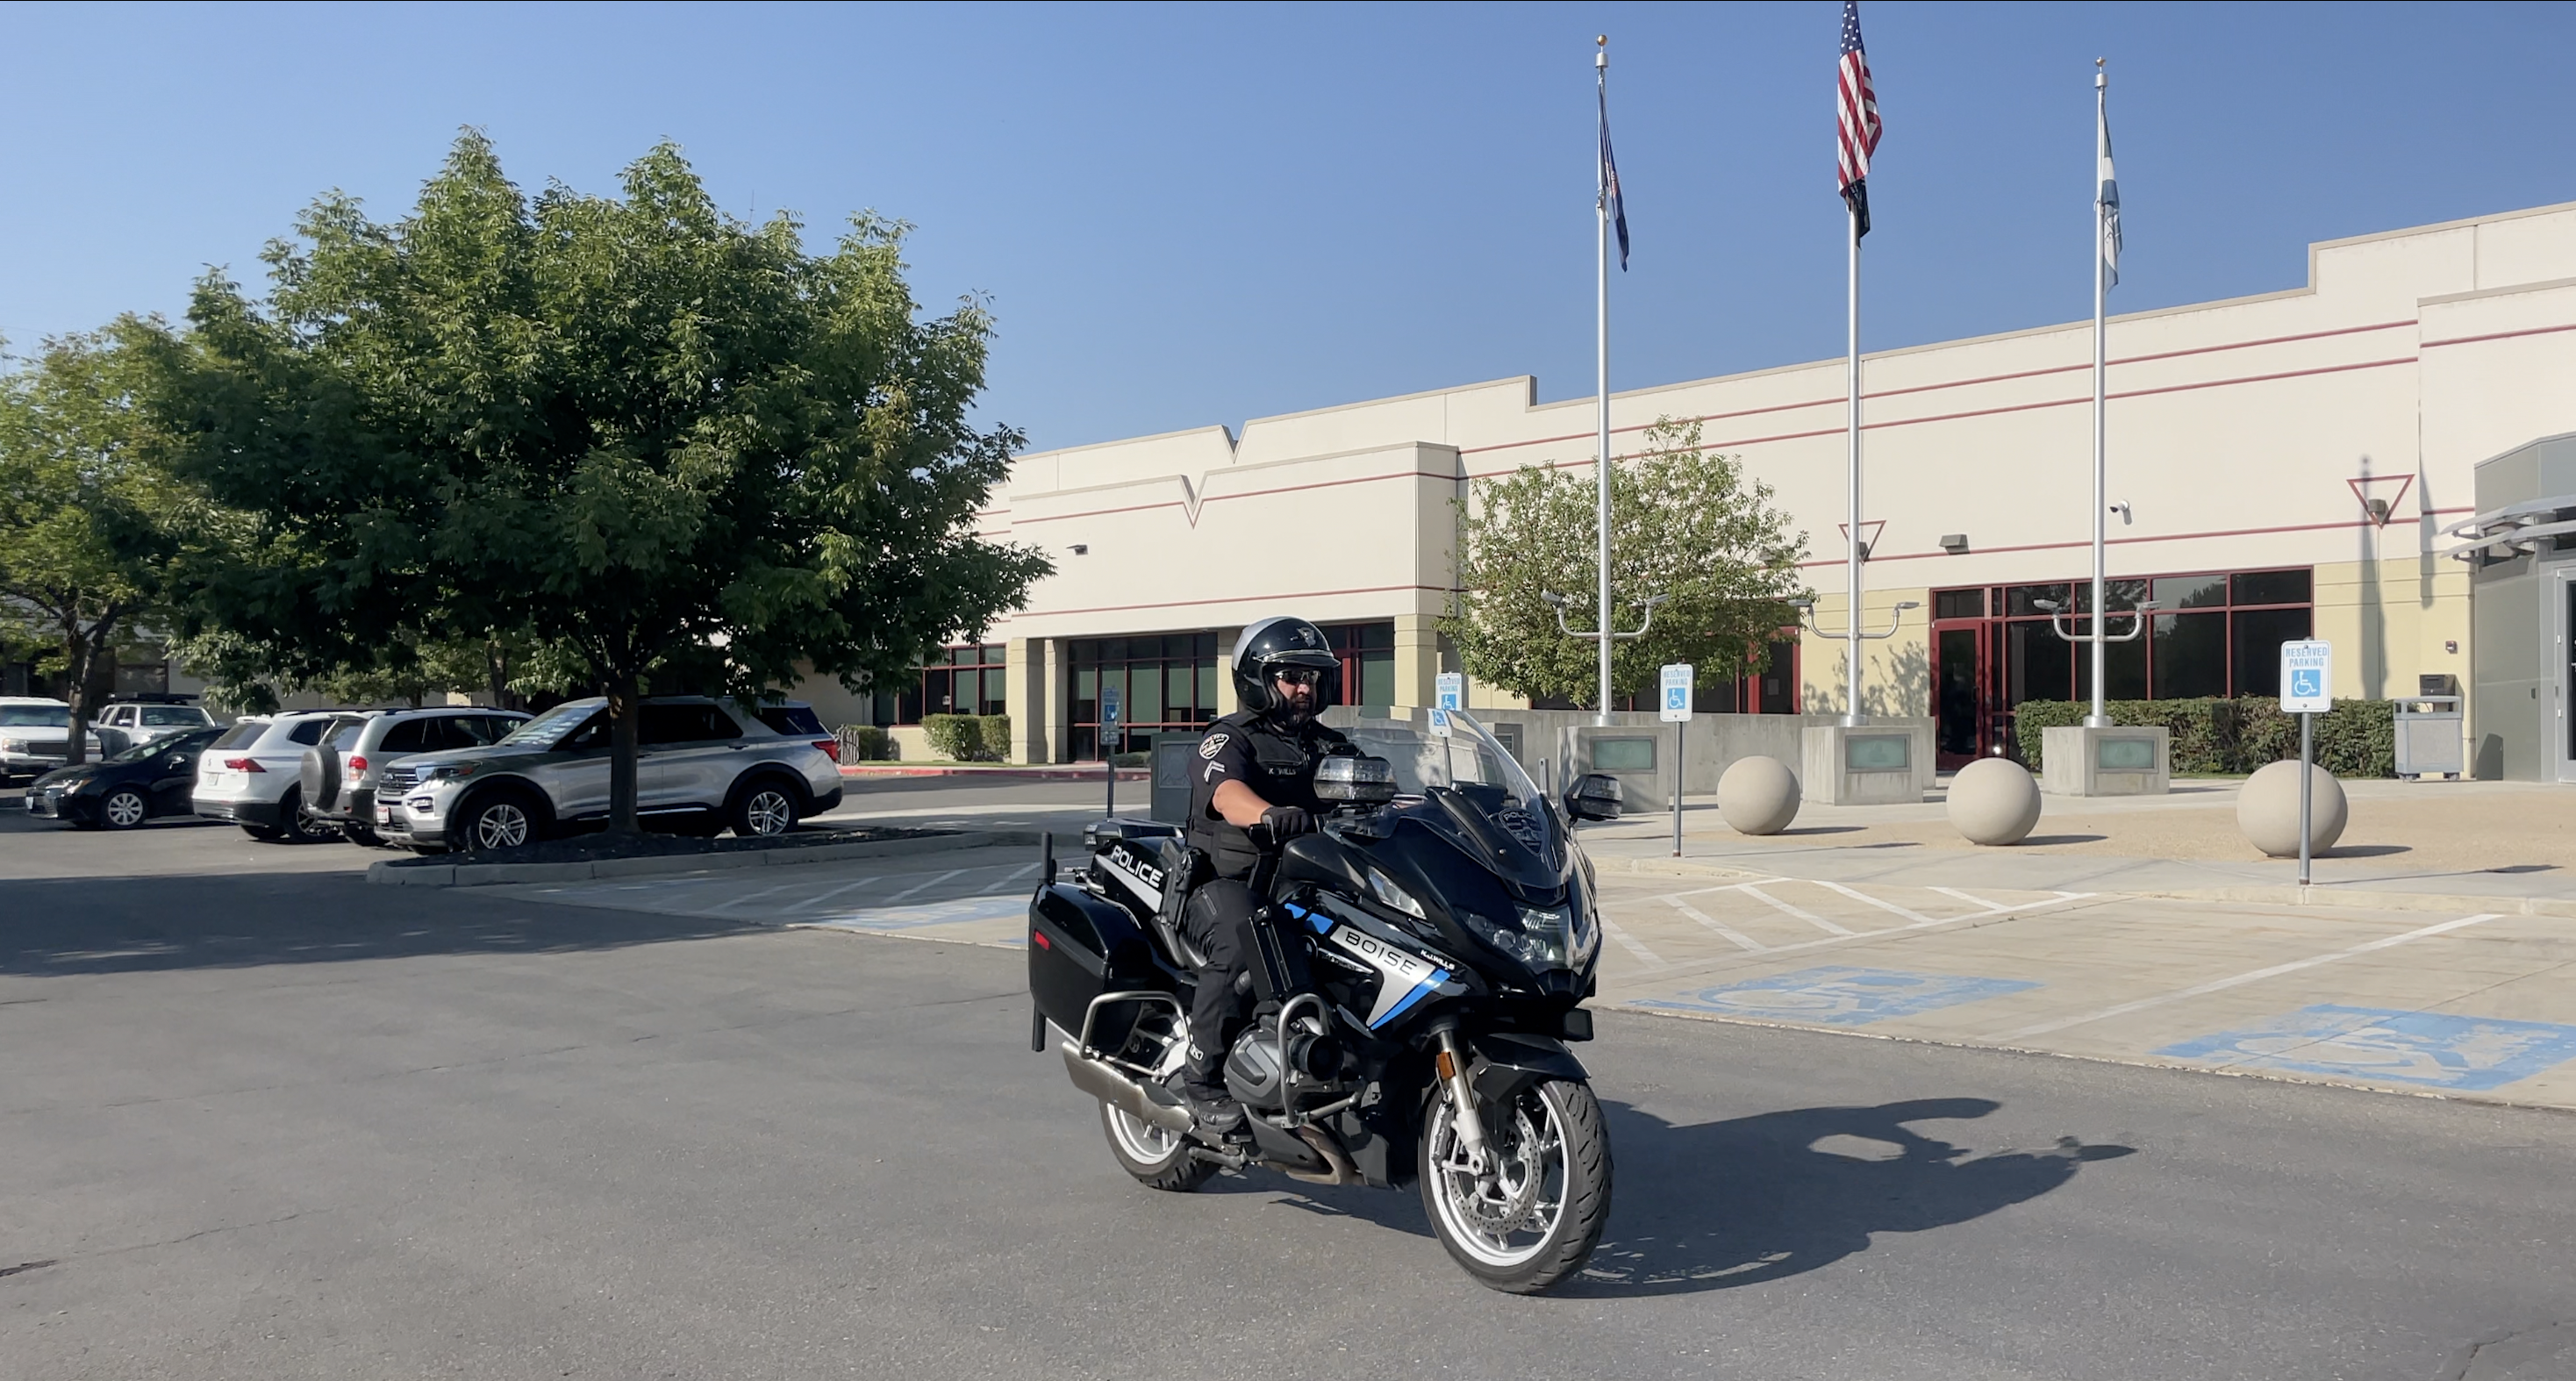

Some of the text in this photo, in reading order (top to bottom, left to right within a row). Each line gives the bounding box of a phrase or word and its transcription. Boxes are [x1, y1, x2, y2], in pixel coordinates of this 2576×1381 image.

[2286, 648, 2328, 657] RESERVED
[2289, 658, 2324, 667] PARKING
[1111, 845, 1163, 888] POLICE
[1345, 931, 1417, 976] BOISE
